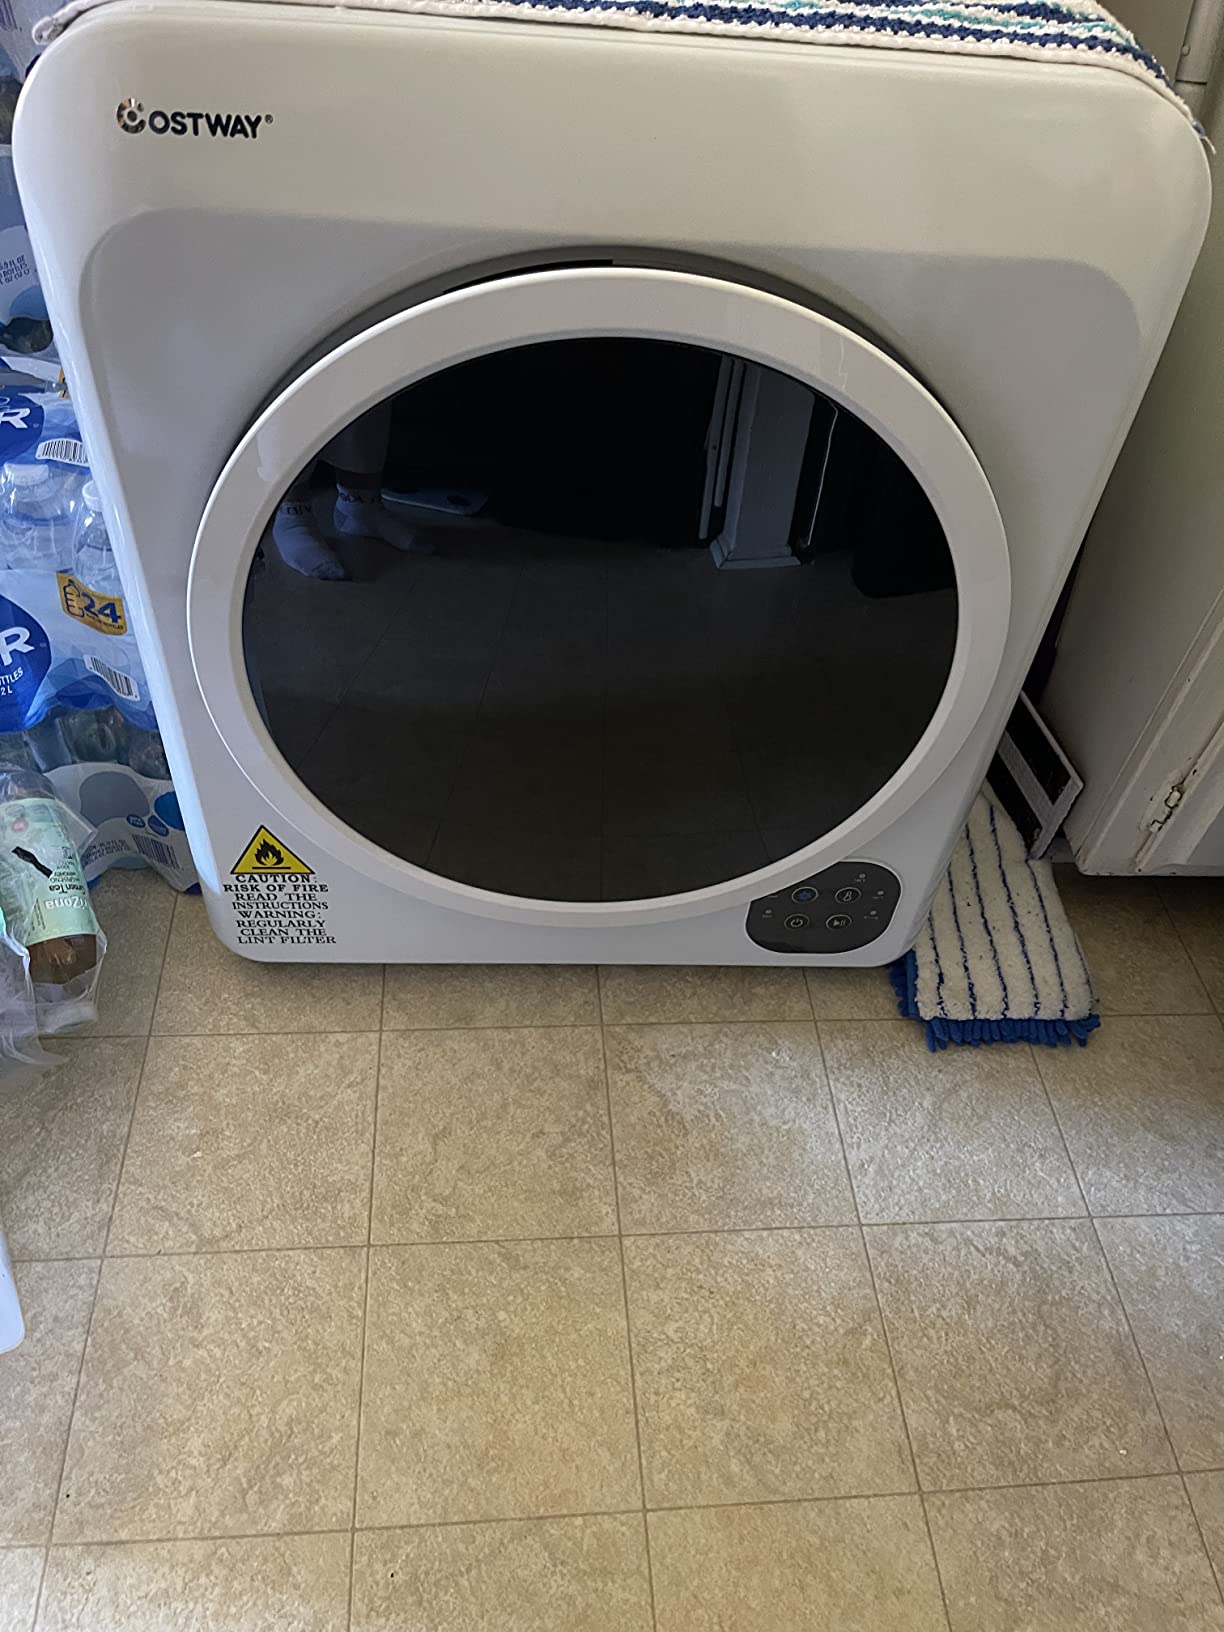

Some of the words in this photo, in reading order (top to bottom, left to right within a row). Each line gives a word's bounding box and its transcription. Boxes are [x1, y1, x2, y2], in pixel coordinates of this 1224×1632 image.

[81, 592, 122, 624] 24
[0, 666, 24, 686] TTLES
[235, 874, 318, 883] CAUTION:
[49, 884, 68, 895] Tea
[223, 884, 261, 892] RISK
[266, 884, 286, 892] OF
[293, 884, 329, 892] FIRE
[235, 893, 278, 901] READ
[285, 893, 317, 901] THE
[232, 902, 329, 910] INSTRUCTIONS
[237, 911, 321, 919] WARNING:
[236, 920, 325, 928] REGULARLY
[240, 928, 289, 936] CLEAN
[296, 928, 327, 936] THE
[238, 936, 276, 944] LINT
[281, 936, 337, 944] FILTER
